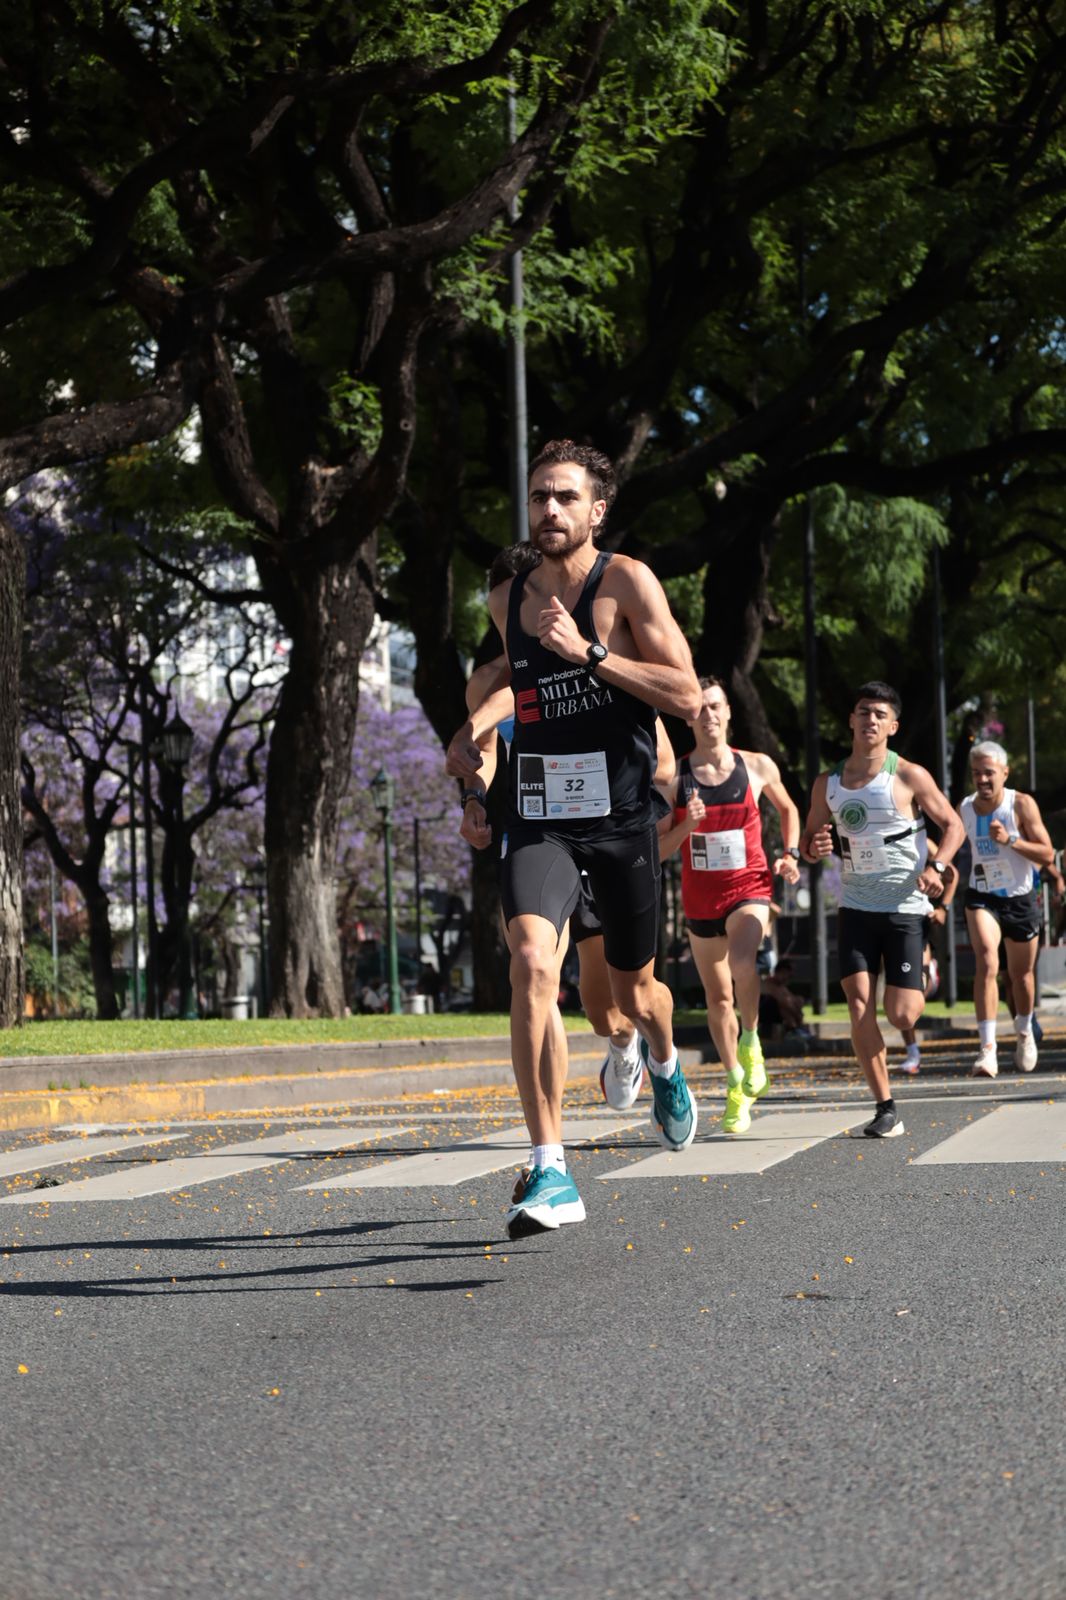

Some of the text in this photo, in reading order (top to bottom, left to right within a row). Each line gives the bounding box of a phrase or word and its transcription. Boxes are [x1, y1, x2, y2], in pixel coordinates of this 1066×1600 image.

[513, 660, 528, 669] 2025
[538, 668, 586, 685] new balance
[541, 676, 600, 702] MILLA
[544, 689, 614, 719] URBANA
[520, 783, 544, 791] ELITE
[564, 779, 585, 792] 32
[860, 851, 873, 859] 20
